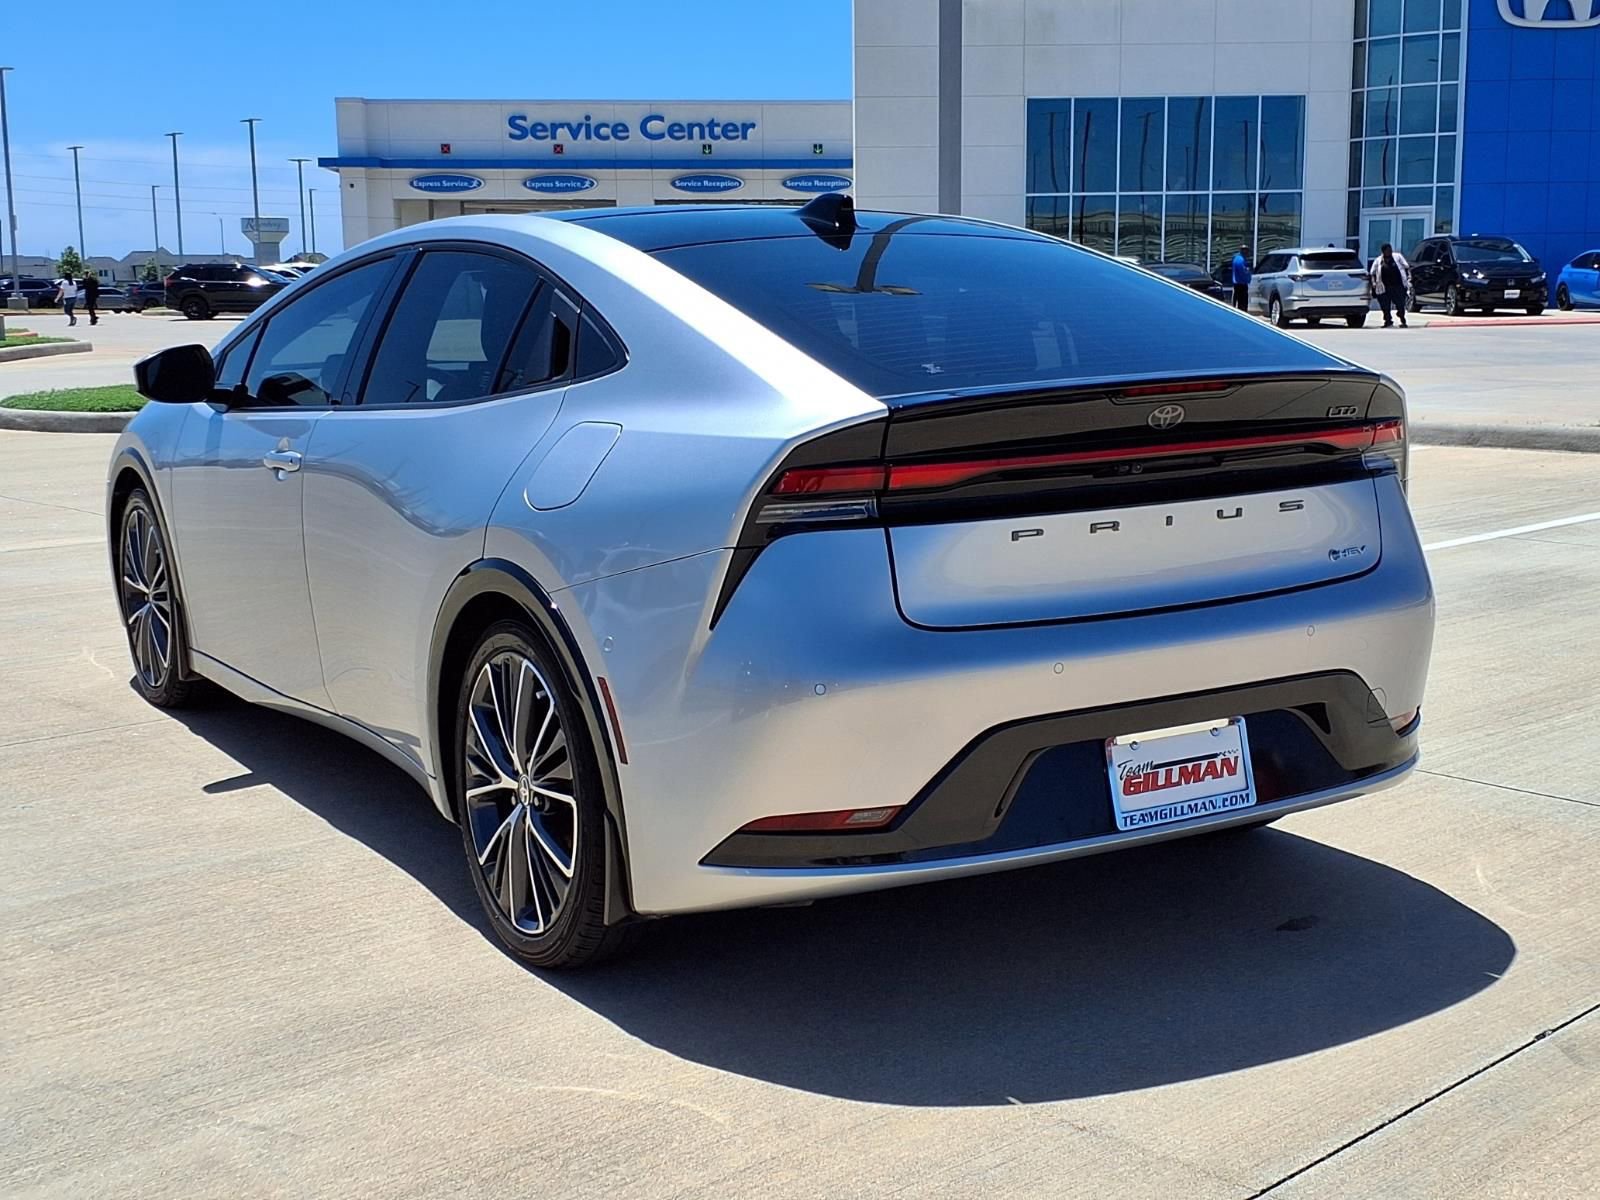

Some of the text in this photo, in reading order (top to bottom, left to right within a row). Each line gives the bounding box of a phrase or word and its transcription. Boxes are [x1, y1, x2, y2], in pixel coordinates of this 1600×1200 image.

[508, 115, 756, 141] Service Center
[413, 180, 441, 188] Express
[703, 180, 740, 188] Reception
[814, 180, 850, 188] Reception
[1011, 500, 1304, 541] PRIUS
[1117, 759, 1155, 781] Team
[1122, 755, 1239, 796] GILLMAN
[1122, 792, 1250, 827] TEAMGILLMAN.COM
